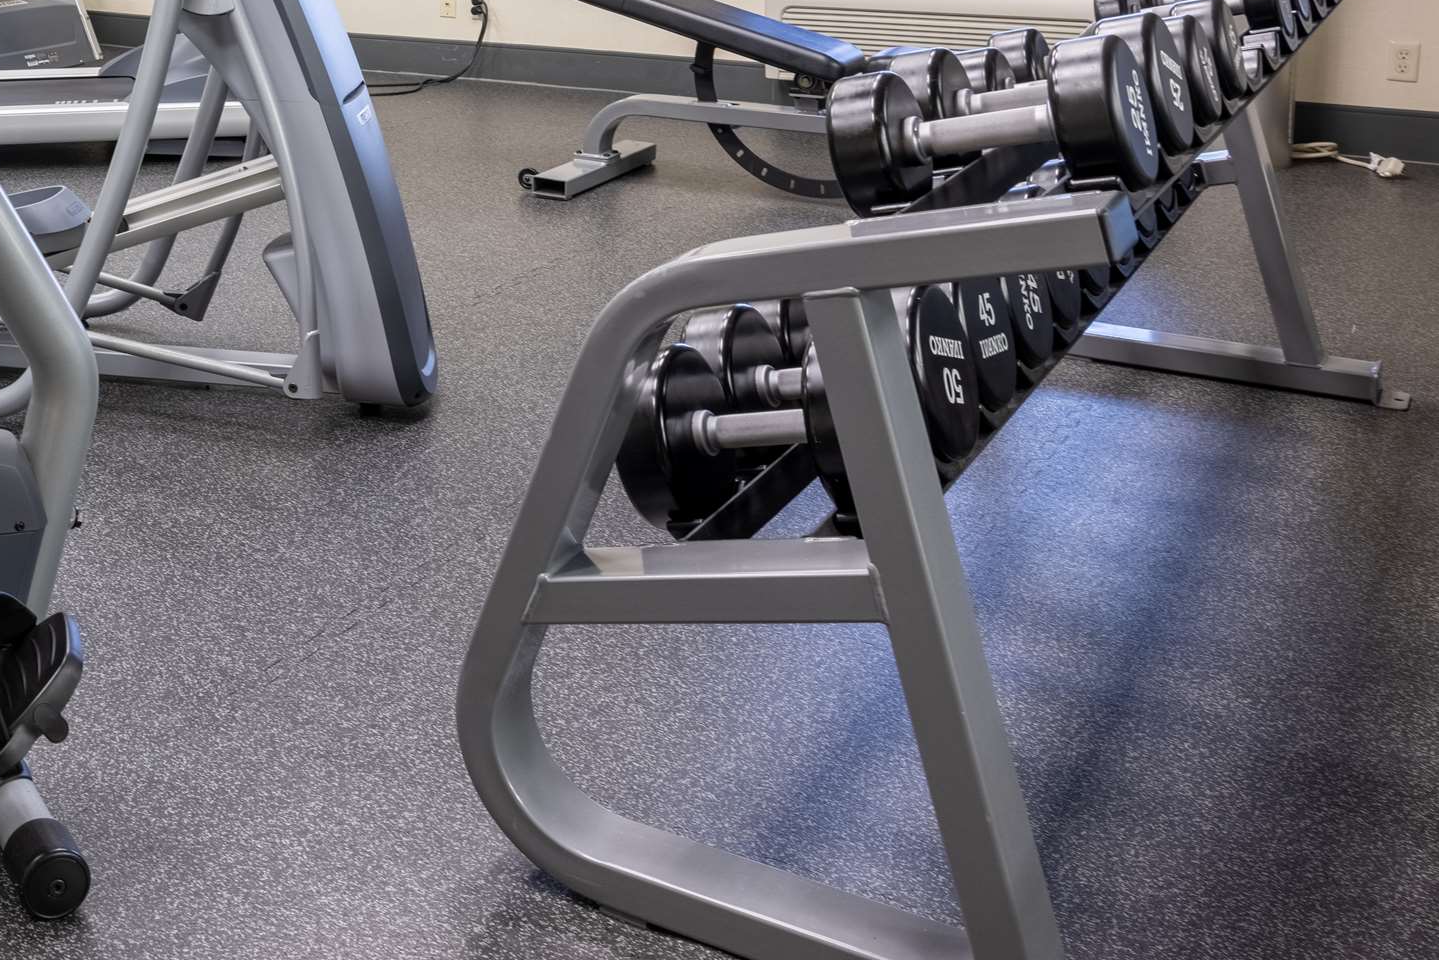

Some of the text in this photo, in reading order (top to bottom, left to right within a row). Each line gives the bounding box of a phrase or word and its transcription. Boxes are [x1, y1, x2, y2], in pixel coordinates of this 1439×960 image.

[1126, 85, 1142, 132] 25
[978, 292, 996, 327] 45
[1027, 274, 1043, 314] 45
[929, 335, 964, 360] IVANKO
[979, 332, 1009, 360] IVANKO
[943, 367, 965, 404] 50
